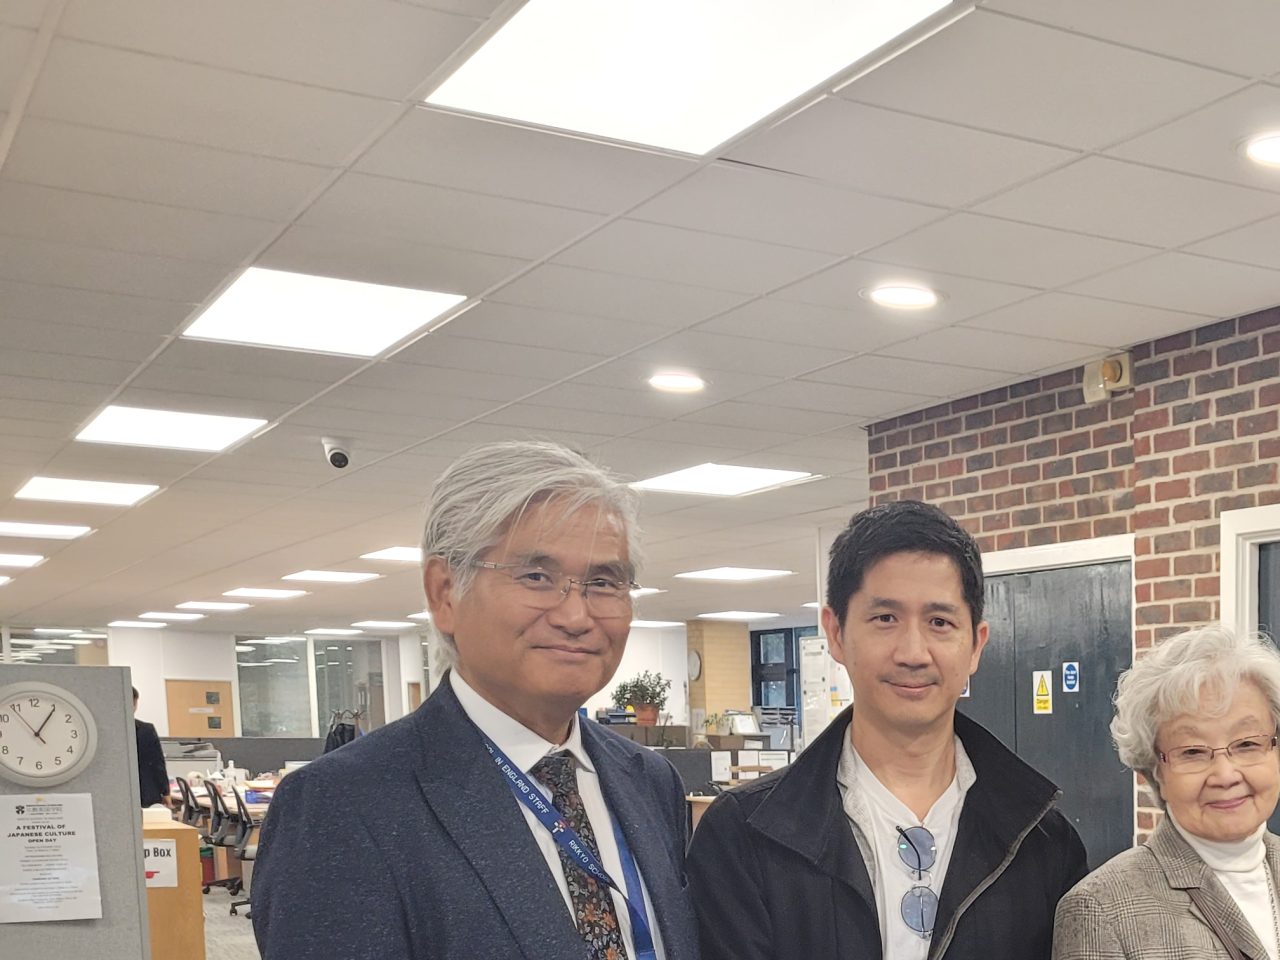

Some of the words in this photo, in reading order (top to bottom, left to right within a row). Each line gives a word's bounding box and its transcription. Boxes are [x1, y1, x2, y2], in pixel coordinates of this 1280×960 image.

[28, 698, 40, 708] 12
[65, 714, 72, 723] 2
[70, 730, 78, 738] 3
[2, 746, 9, 754] 8
[66, 746, 73, 754] 4
[17, 756, 24, 765] 7
[54, 756, 62, 765] 5
[36, 761, 43, 770] 6
[494, 756, 504, 766] IN
[502, 764, 530, 794] ENGLAND
[528, 793, 550, 814] STAFF
[153, 847, 171, 857] Box
[569, 840, 589, 863] RIKKYO
